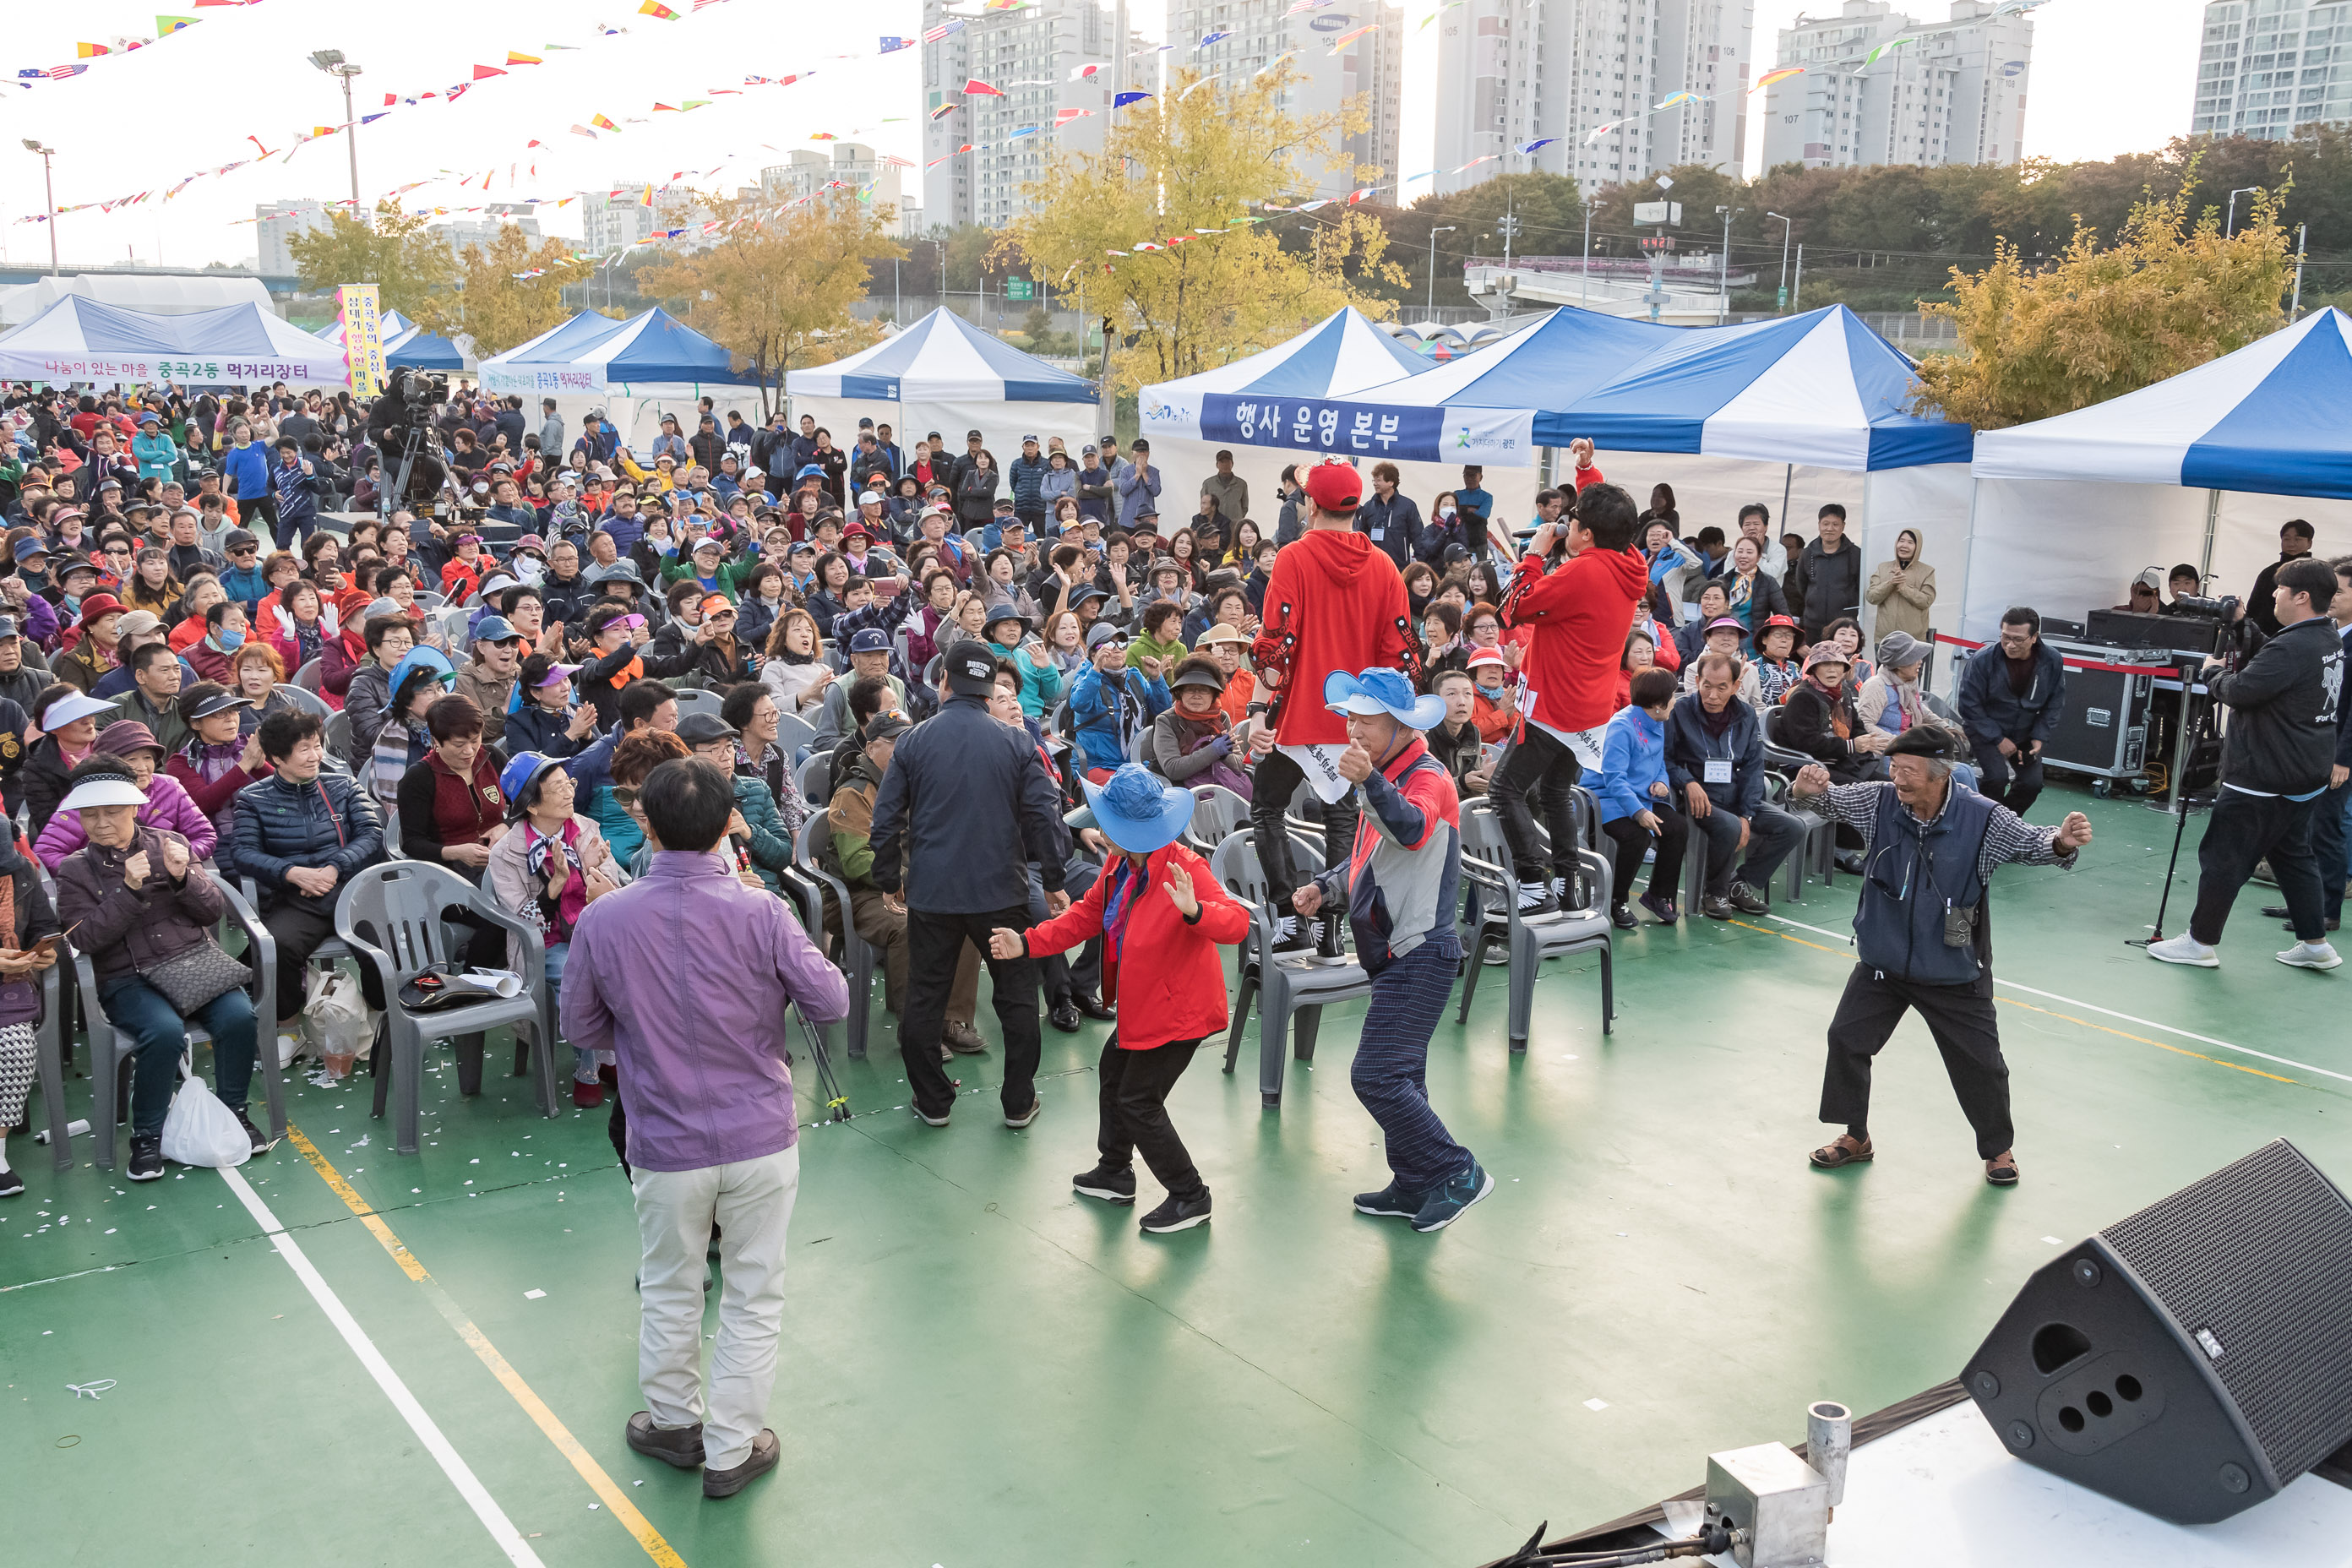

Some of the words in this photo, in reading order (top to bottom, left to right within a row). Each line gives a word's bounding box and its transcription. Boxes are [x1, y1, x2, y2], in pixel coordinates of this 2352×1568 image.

[1445, 26, 1458, 36] 105
[1723, 47, 1735, 56] 106
[1085, 74, 1098, 84] 102
[1784, 115, 1799, 124] 107
[347, 297, 360, 330] 삼대가
[362, 297, 377, 344] 중곡동의
[351, 334, 364, 367] 행복한
[45, 361, 86, 376] 나눔이
[91, 362, 117, 377] 있는
[121, 362, 149, 378] 마을
[157, 362, 220, 379] 중곡2동
[226, 362, 308, 380] 먹거리장터
[355, 371, 368, 392] 마을
[536, 373, 558, 389] 중곡1동
[560, 373, 591, 389] 먹거리장터
[1236, 401, 1281, 439] 행사
[1293, 406, 1339, 447] 운영
[1350, 411, 1400, 450] 본부
[1502, 438, 1515, 449] 광진
[1257, 643, 1288, 669] STORE
[2315, 715, 2329, 723] For
